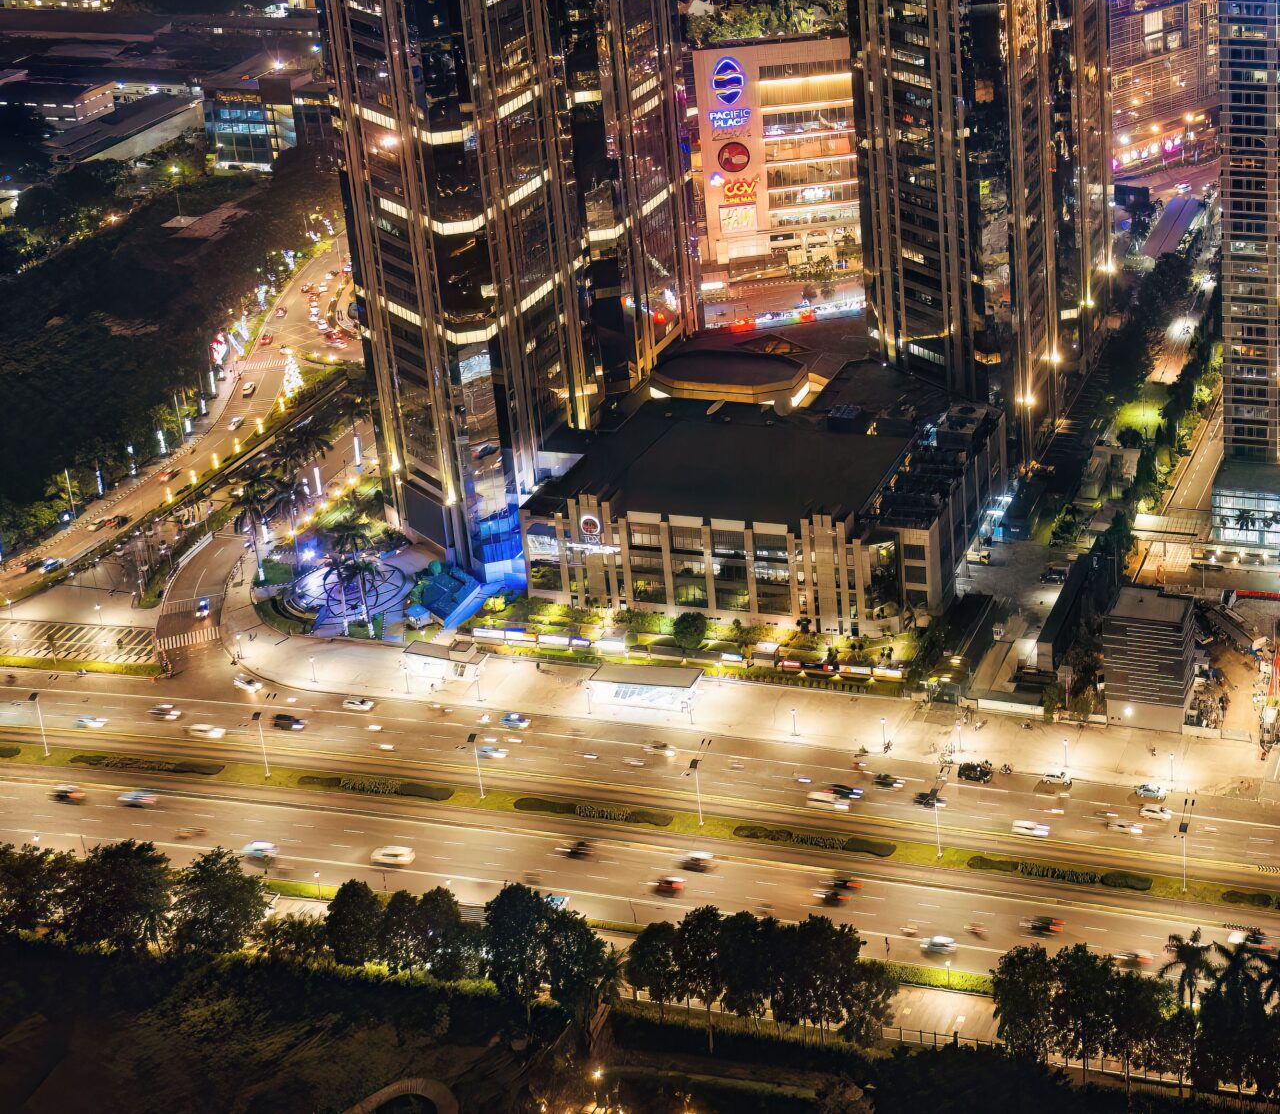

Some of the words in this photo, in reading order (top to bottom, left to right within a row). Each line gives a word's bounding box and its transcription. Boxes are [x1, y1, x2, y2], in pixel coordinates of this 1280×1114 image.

[709, 108, 751, 121] PACIFIC
[713, 117, 748, 128] PLACE
[724, 180, 757, 196] CGV
